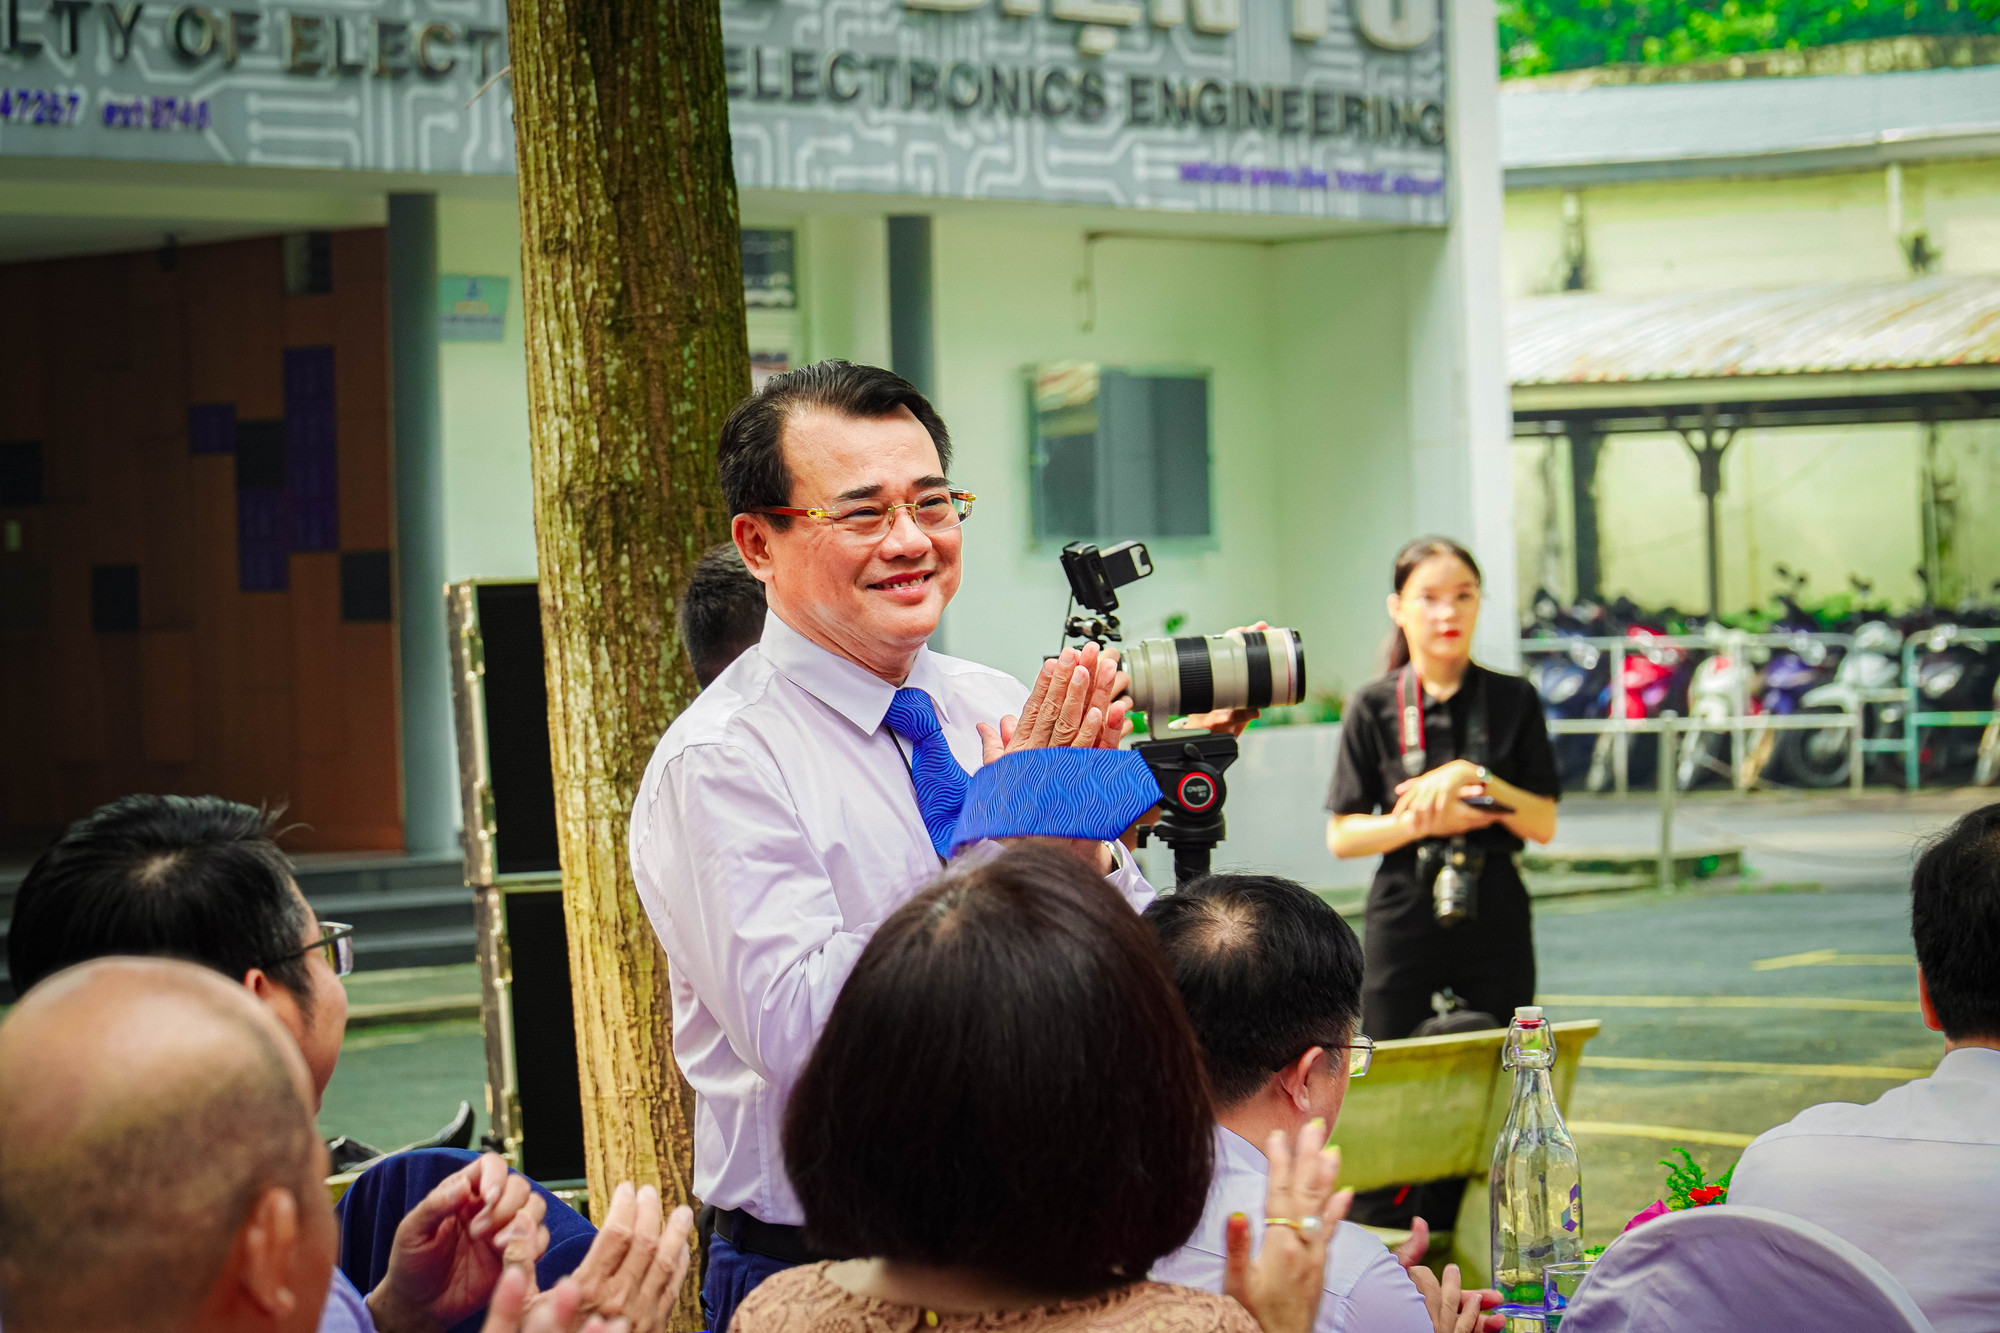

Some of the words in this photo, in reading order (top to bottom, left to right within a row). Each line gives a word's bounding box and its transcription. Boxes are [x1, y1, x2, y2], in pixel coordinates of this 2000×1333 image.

[168, 7, 262, 69] OF
[722, 44, 1106, 120] ELECTRONICS
[1125, 75, 1446, 147] ENGINEERING
